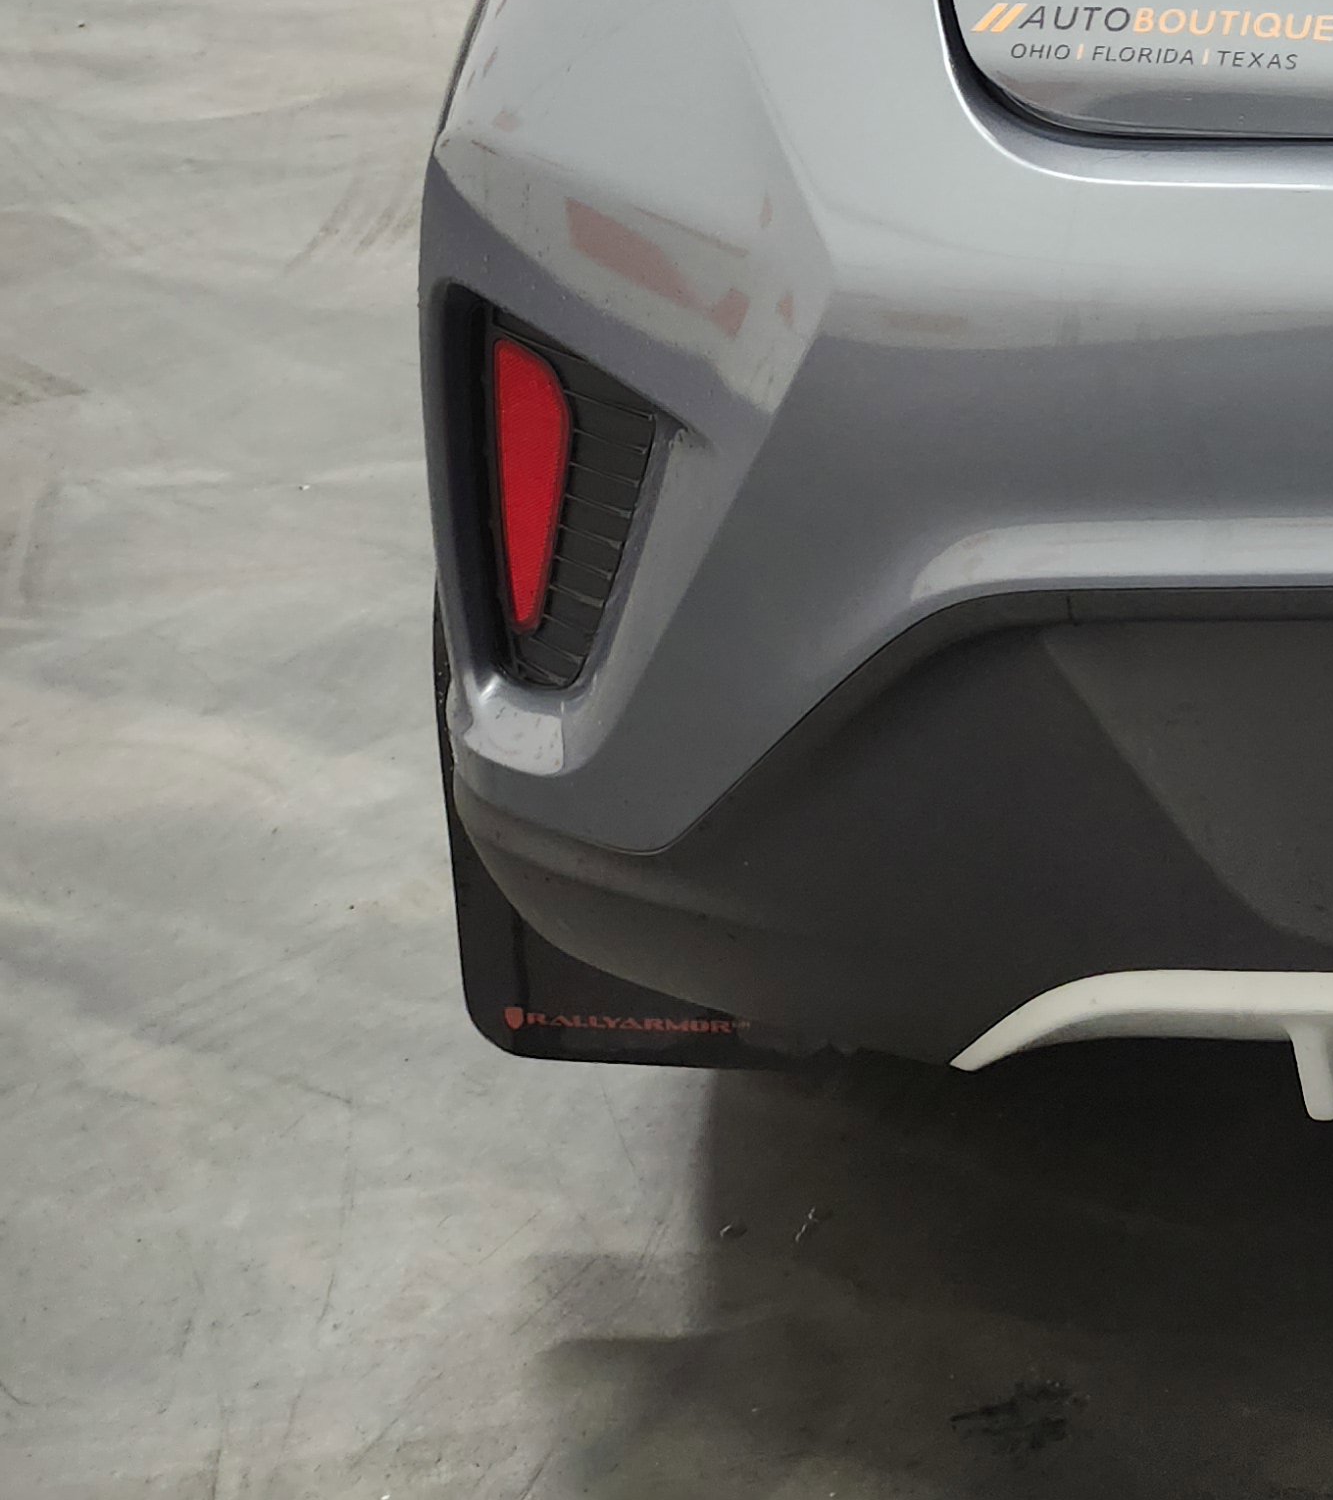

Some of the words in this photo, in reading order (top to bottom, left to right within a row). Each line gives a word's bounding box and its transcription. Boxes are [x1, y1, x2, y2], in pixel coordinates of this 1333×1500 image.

[1011, 43, 1071, 61] OHIO
[1092, 46, 1195, 66] FLORIDA
[1218, 51, 1298, 70] TEXAS
